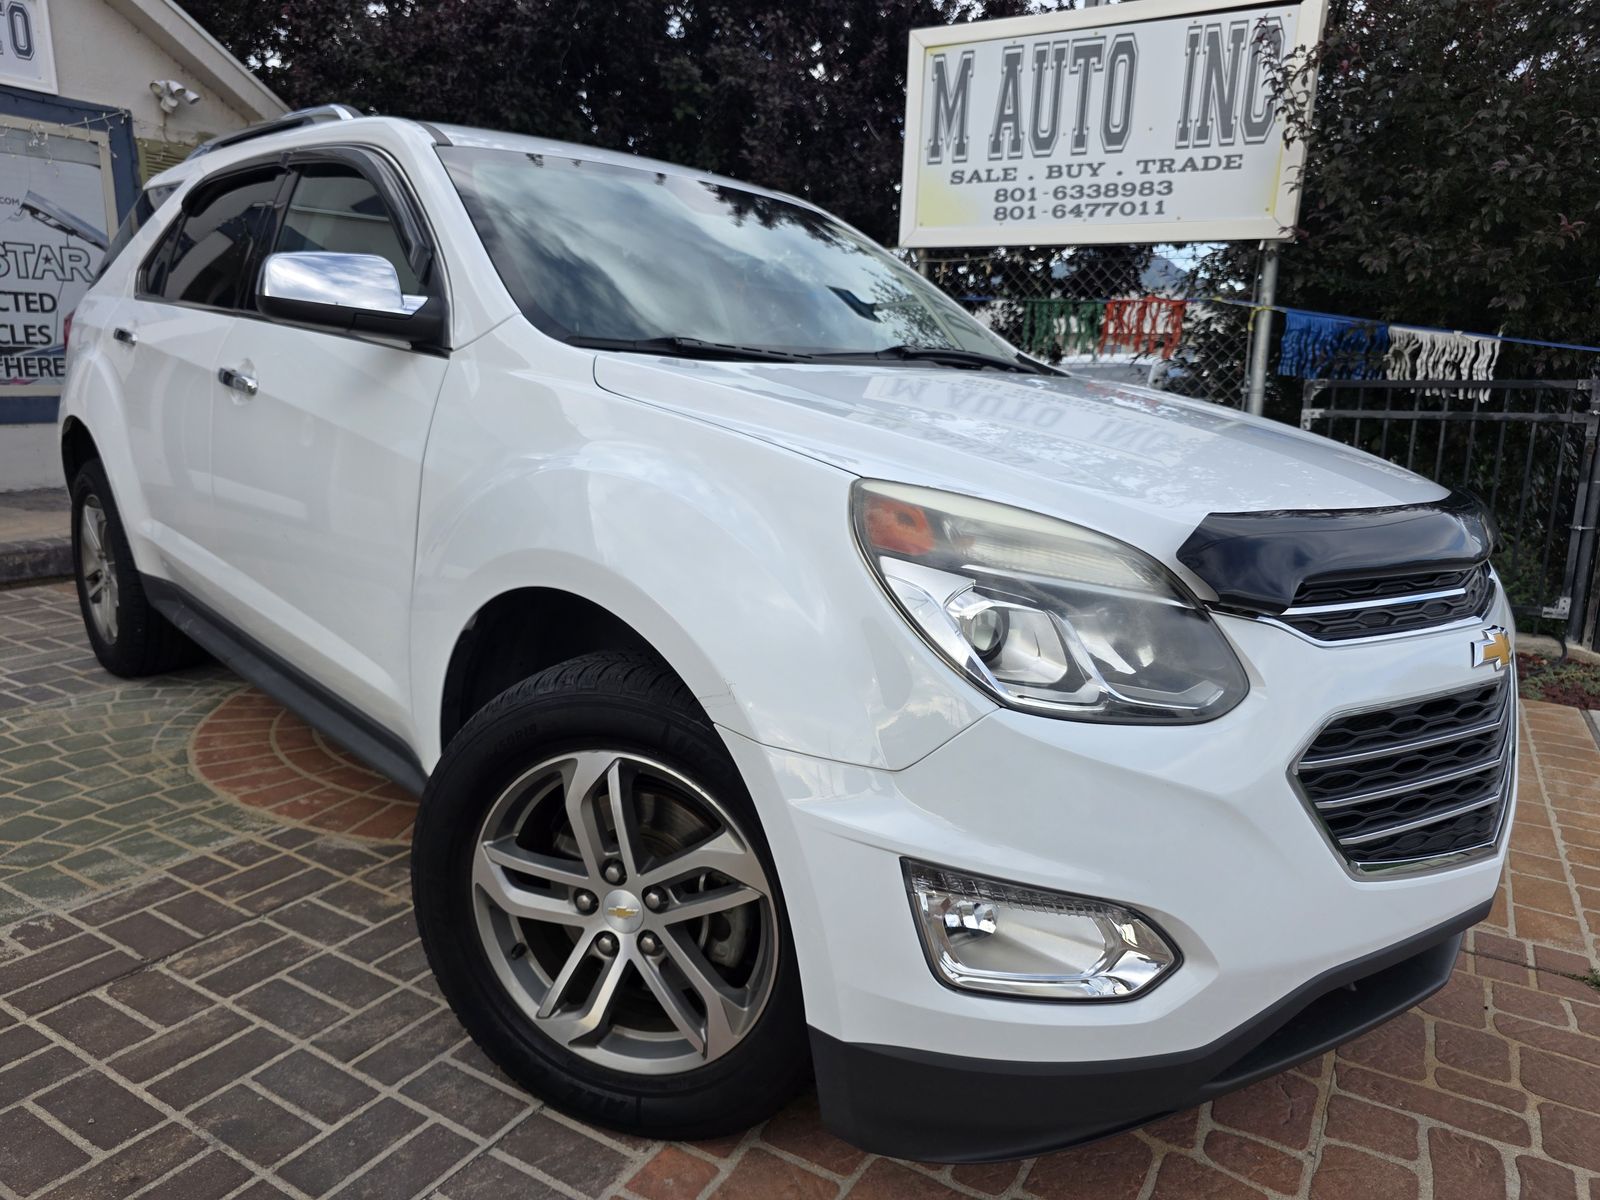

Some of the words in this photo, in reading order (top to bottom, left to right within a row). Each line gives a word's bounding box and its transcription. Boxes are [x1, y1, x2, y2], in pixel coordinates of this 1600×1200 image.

[927, 51, 975, 164] M
[988, 33, 1139, 159] AUTO
[1175, 16, 1285, 148] INC
[950, 167, 1018, 186] SALE
[1046, 161, 1106, 180] BUY
[1136, 153, 1244, 175] TRADE
[994, 180, 1174, 203] 801-6338983
[993, 200, 1166, 221] 801-6477011
